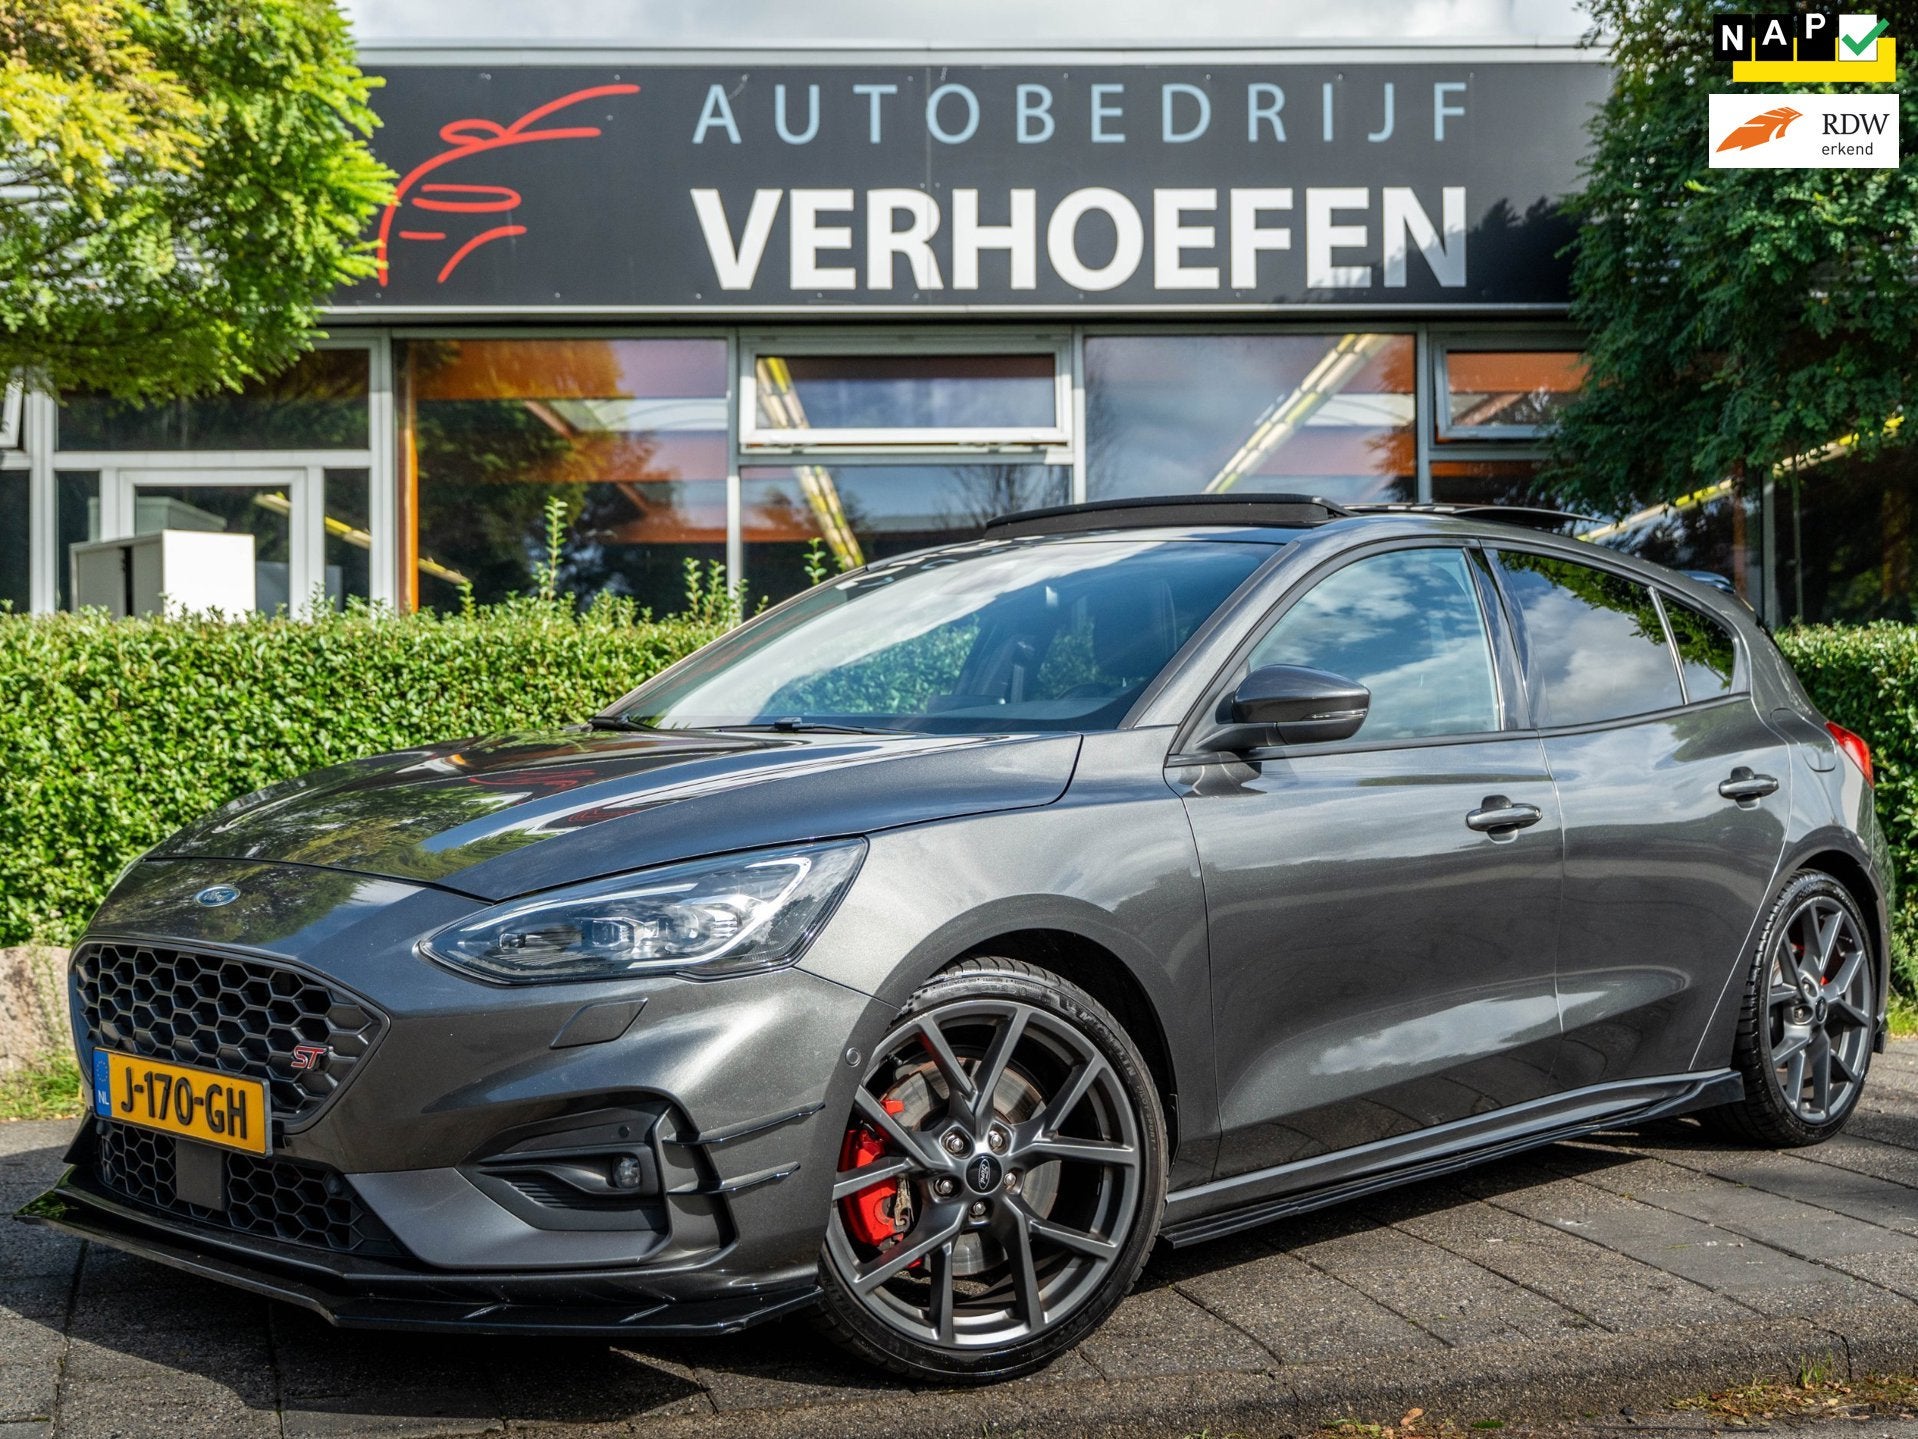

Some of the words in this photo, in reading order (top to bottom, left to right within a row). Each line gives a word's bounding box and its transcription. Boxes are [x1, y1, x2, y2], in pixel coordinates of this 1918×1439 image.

[692, 82, 1467, 145] AUTOBEDRIJF
[690, 187, 1467, 292] VERHOEFEN
[291, 1045, 327, 1069] ST
[97, 1089, 110, 1105] NL
[121, 1066, 248, 1140] J-170-GH
